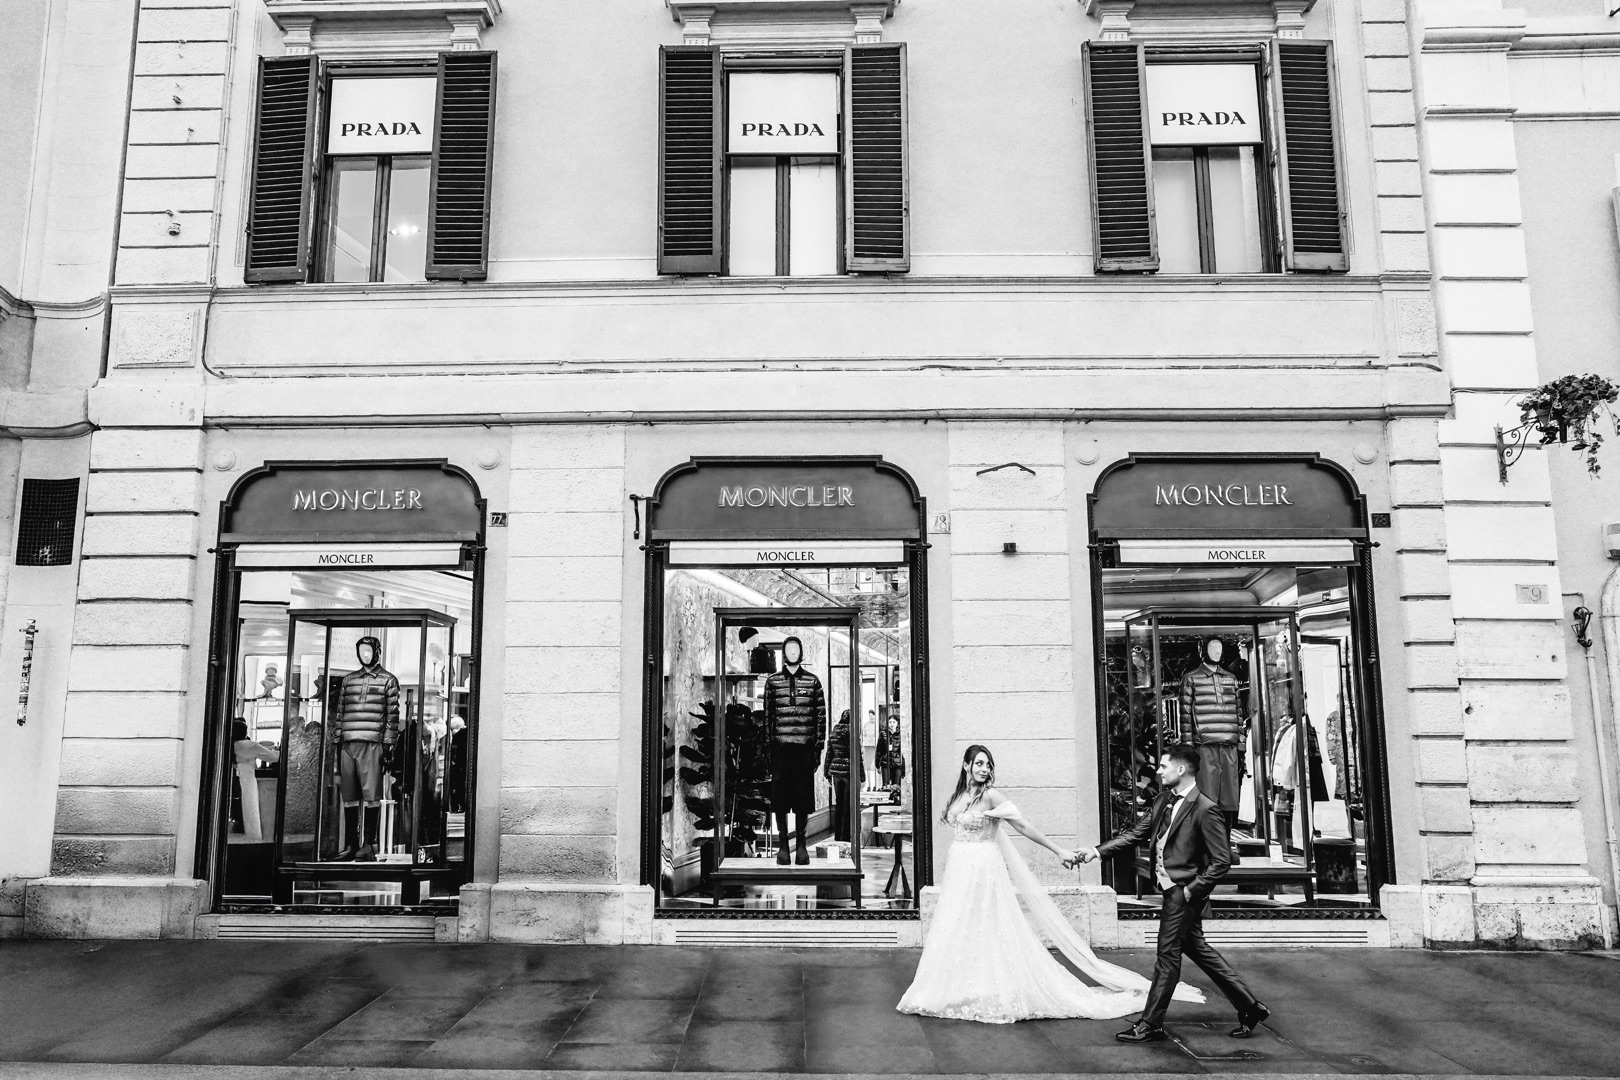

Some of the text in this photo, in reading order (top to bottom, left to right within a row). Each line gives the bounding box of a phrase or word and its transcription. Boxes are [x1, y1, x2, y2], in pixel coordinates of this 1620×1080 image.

[1163, 111, 1245, 126] PRADA
[342, 122, 422, 136] PRADA
[742, 123, 825, 136] PRADA
[292, 488, 423, 511] MONCLER
[719, 485, 856, 508] MONCLER
[1155, 483, 1293, 506] MONCLER
[492, 515, 503, 524] 77
[319, 554, 374, 564] MONCLER
[757, 551, 815, 562] MONCLER
[1208, 550, 1266, 561] MONCLER
